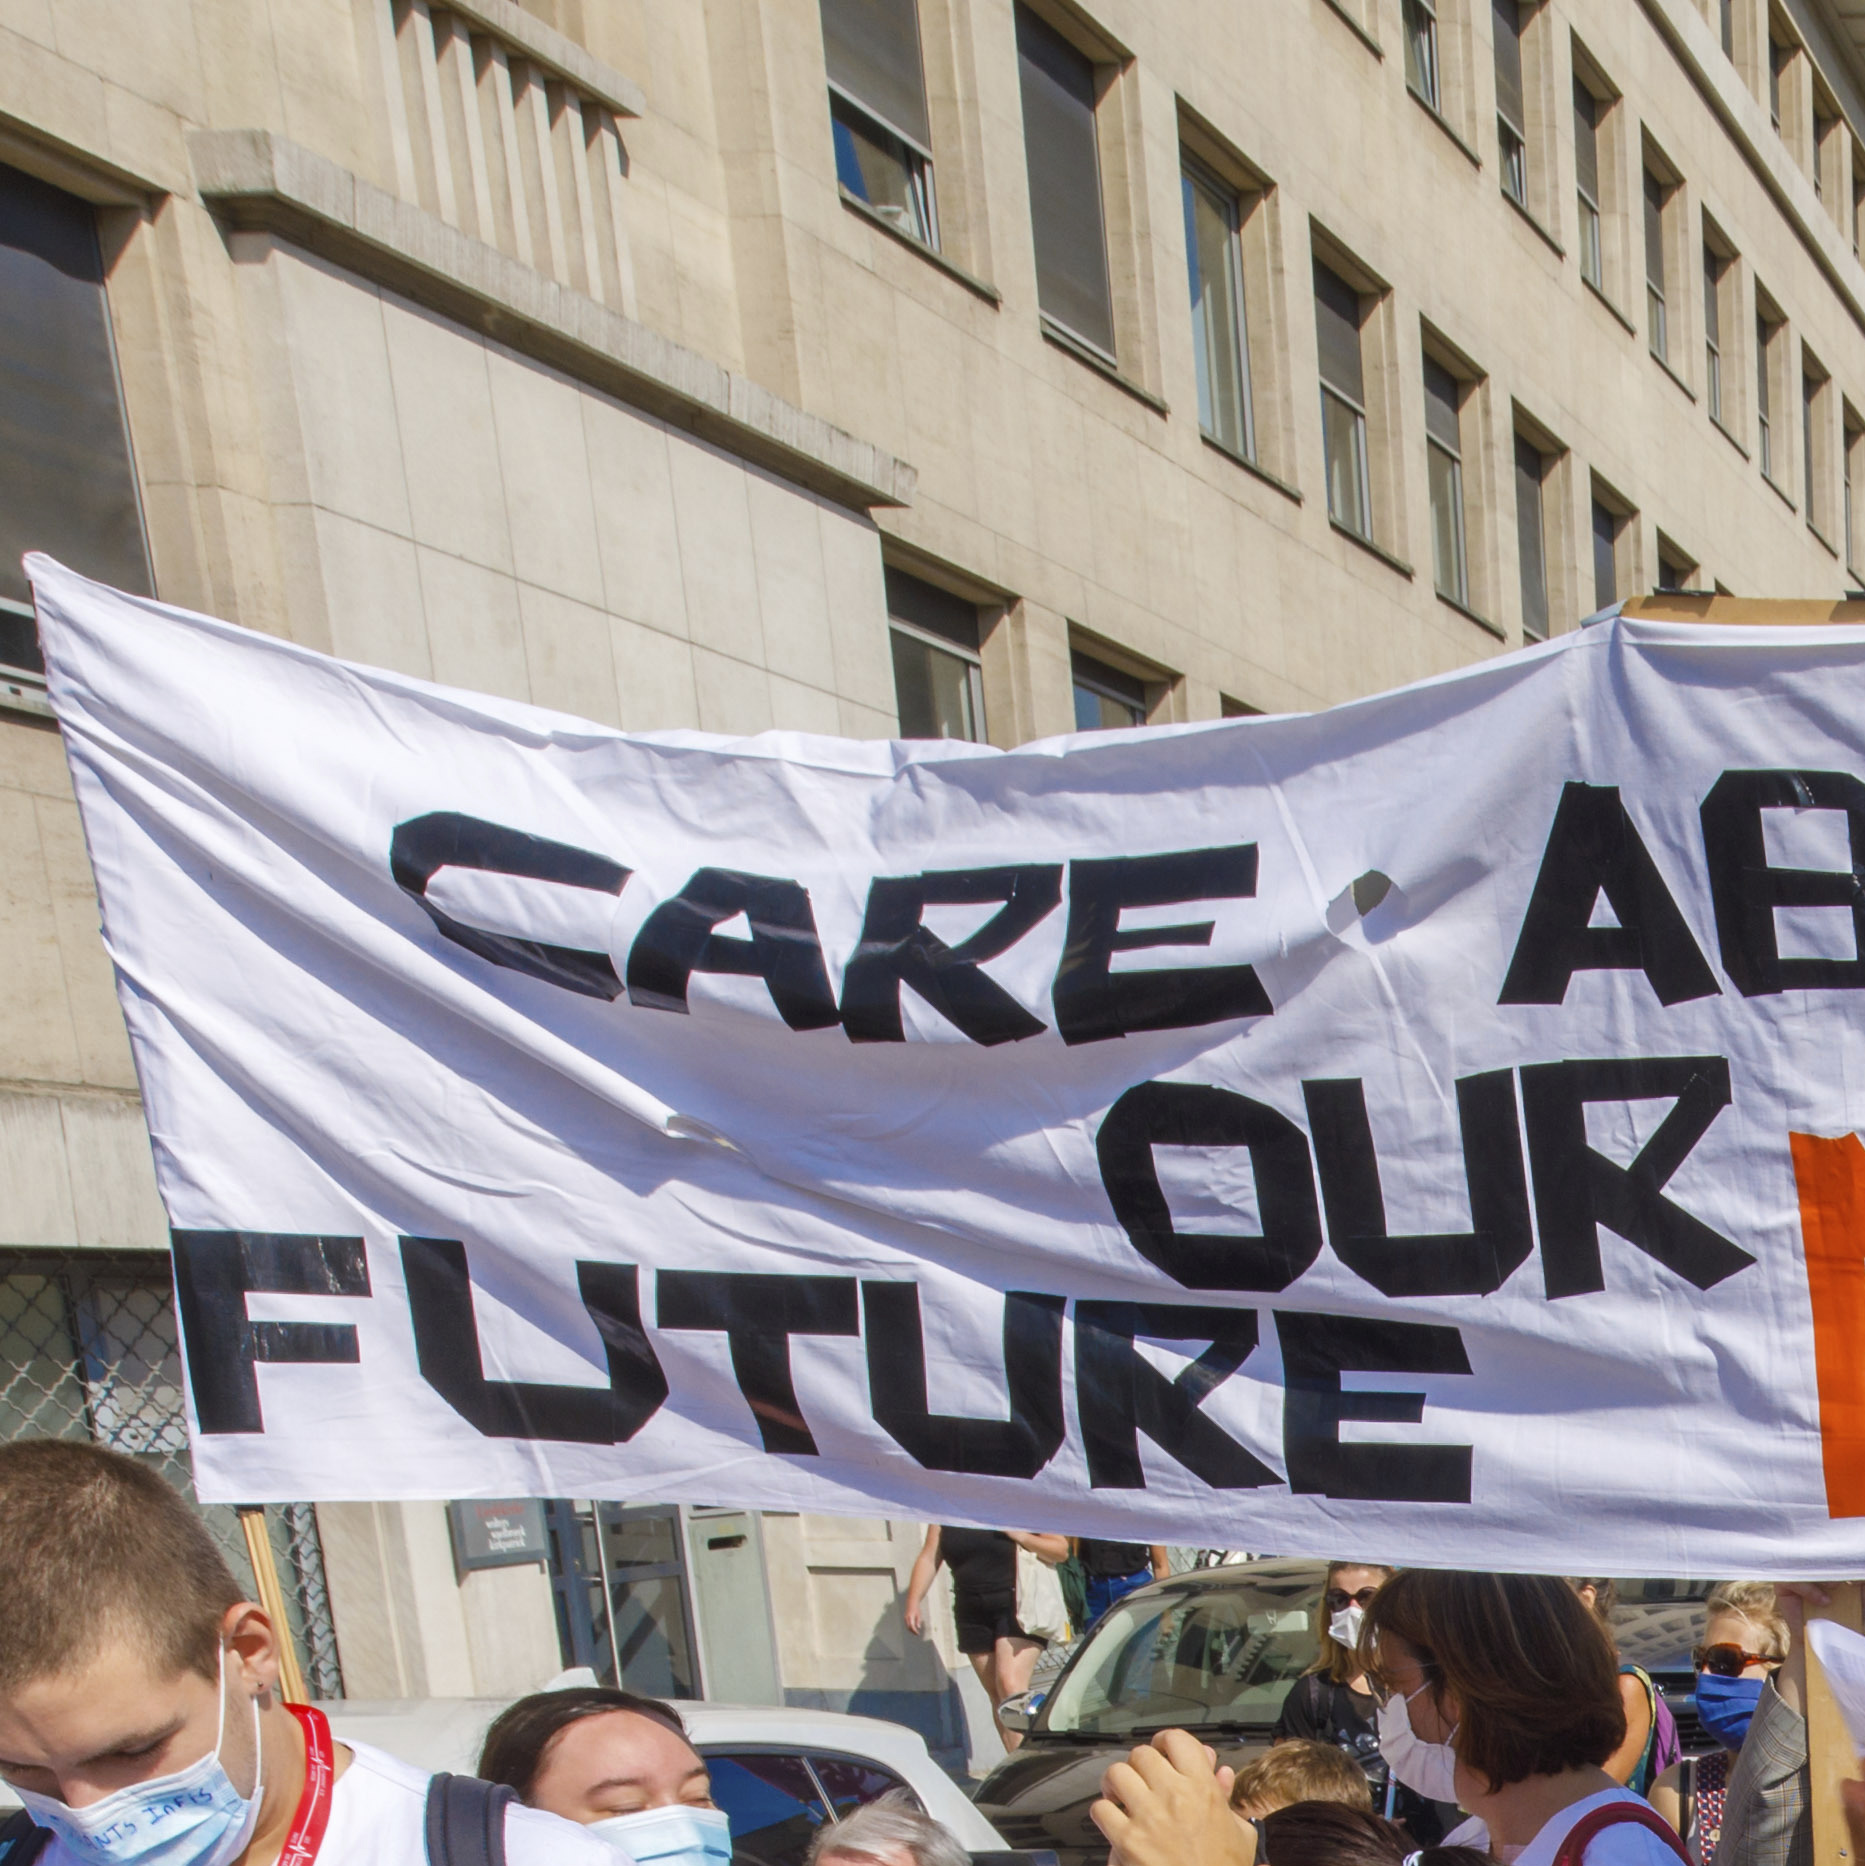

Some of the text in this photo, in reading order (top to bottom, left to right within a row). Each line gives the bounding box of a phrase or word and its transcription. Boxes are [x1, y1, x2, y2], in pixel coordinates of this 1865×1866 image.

[389, 810, 1274, 1047] CARE
[1097, 1055, 1757, 1300] OUR
[170, 1228, 1473, 1502] FUTURE
